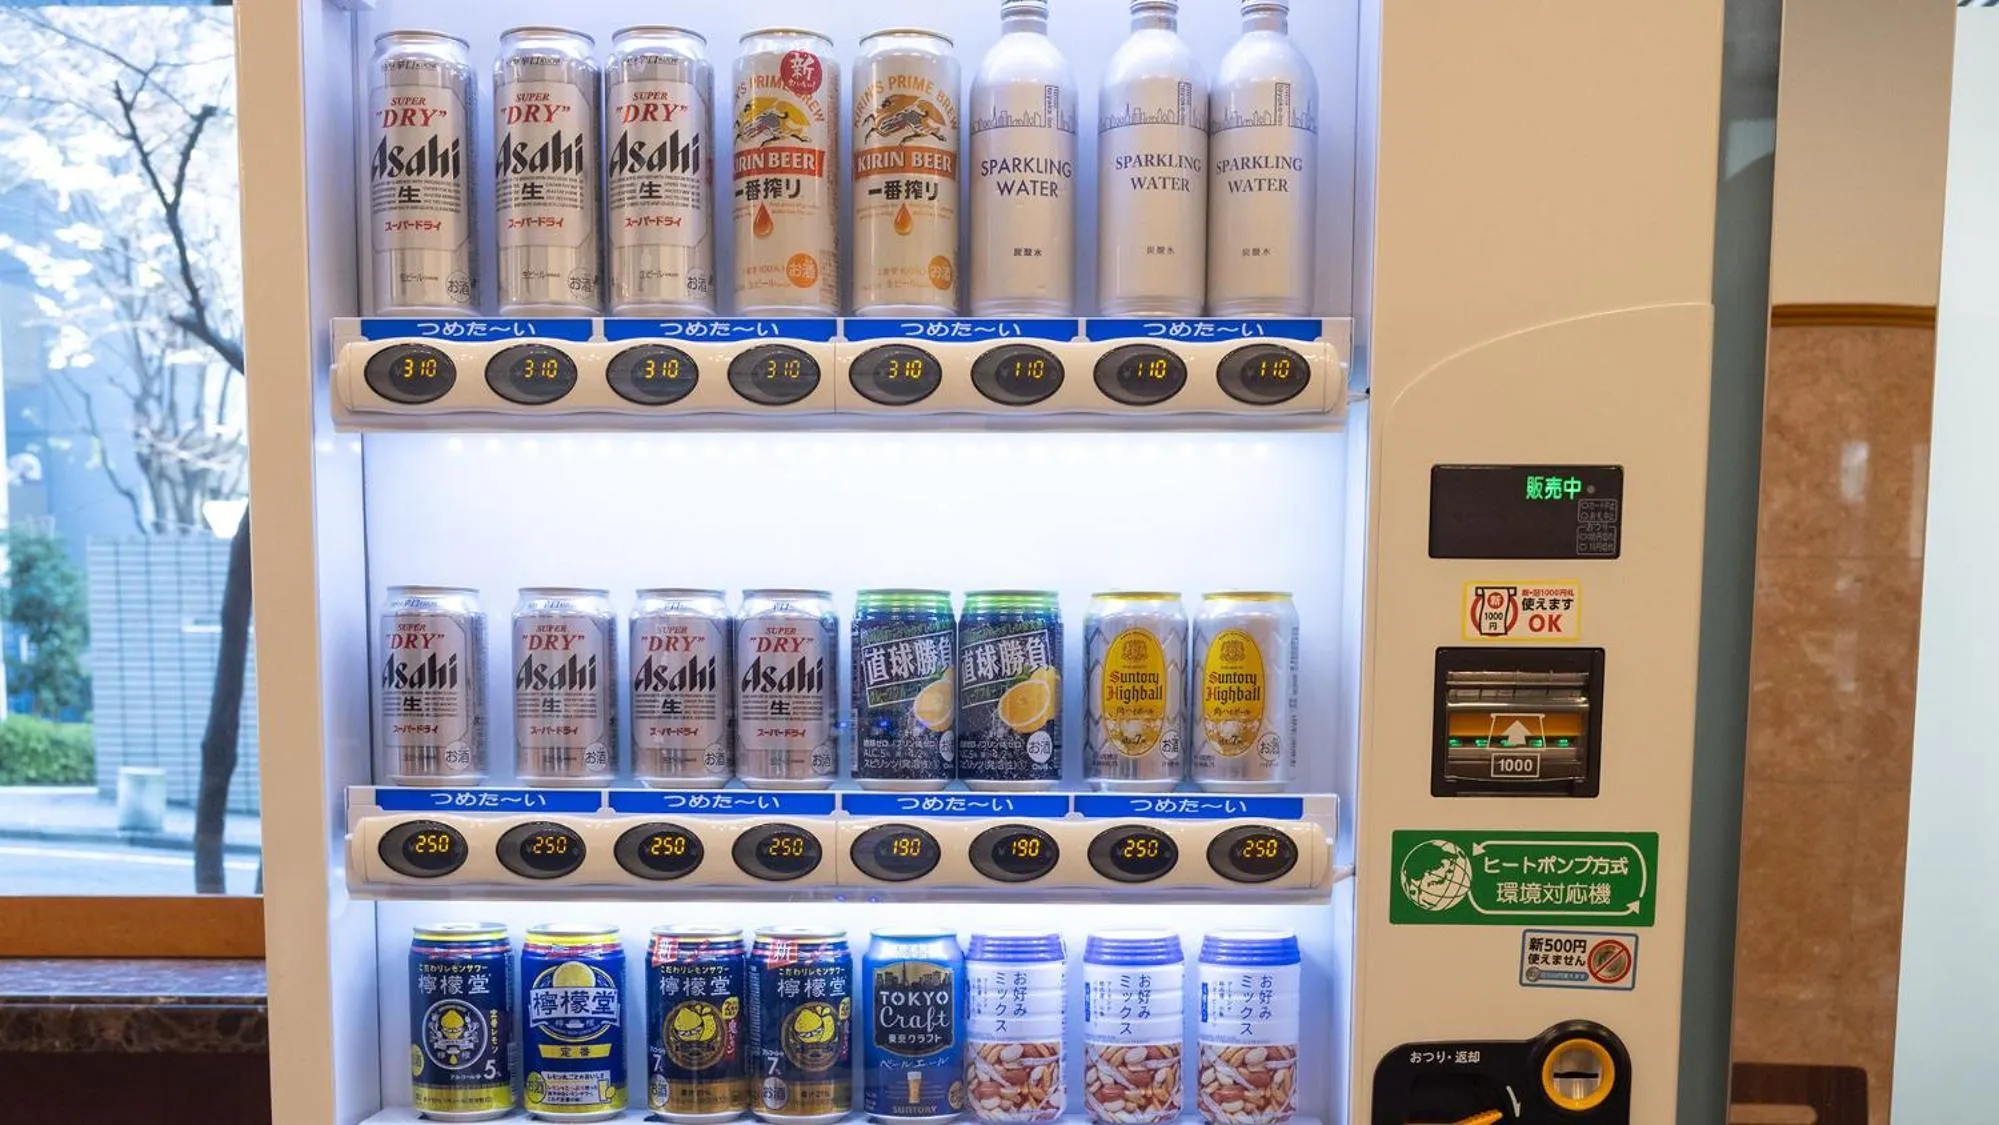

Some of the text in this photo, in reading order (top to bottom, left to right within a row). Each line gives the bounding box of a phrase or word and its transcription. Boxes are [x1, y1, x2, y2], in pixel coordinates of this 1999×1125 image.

[790, 53, 815, 80] 新
[888, 75, 934, 94] PRIME
[391, 96, 426, 106] SUPER
[516, 93, 550, 102] SUPER
[633, 91, 668, 101] SUPER
[371, 134, 460, 182] Asahi
[496, 130, 583, 178] Asahi
[610, 130, 699, 178] Asahi
[768, 152, 815, 169] BEER
[857, 151, 952, 172] KIRIN BEER
[1115, 154, 1201, 172] SPARKLING
[981, 157, 1072, 178] SPARKLING
[1216, 155, 1302, 173] SPARKLING
[521, 182, 544, 200] 生
[639, 182, 662, 199] 生
[735, 178, 800, 200] 一番搾り
[868, 180, 938, 200] 一番搾り
[997, 180, 1058, 198] WATER
[1131, 176, 1190, 192] WATER
[1228, 178, 1288, 193] WATER
[398, 186, 421, 204] 生
[385, 220, 441, 232] スーパードライ
[507, 217, 564, 229] スーパードライ
[625, 217, 682, 228] スーパードライ
[403, 359, 437, 378] 310
[524, 359, 557, 378] 310
[644, 359, 678, 379] 310
[766, 359, 800, 379] 310
[888, 359, 922, 379] 310
[1013, 359, 1044, 379] 110
[1137, 359, 1166, 379] 110
[1259, 359, 1290, 379] 110
[1526, 476, 1582, 500] 販売中
[1522, 598, 1574, 611] 使えます
[1485, 612, 1503, 620] 1000
[1529, 614, 1562, 632] OK
[536, 624, 567, 633] SUPER
[656, 626, 688, 634] SUPER
[766, 627, 797, 635] SUPER
[1489, 622, 1497, 630] 円
[382, 652, 458, 689] Asahi
[865, 638, 953, 686] 直球勝負
[961, 638, 1047, 686] 直球勝負
[516, 653, 596, 691] Asahi
[635, 654, 716, 692] Asahi
[742, 656, 823, 693] Asahi
[1110, 671, 1159, 685] Suntory
[1208, 672, 1257, 685] Suntory
[1107, 686, 1163, 704] Highball
[1205, 687, 1260, 704] Highball
[403, 697, 422, 712] 生
[542, 698, 562, 713] 生
[662, 699, 682, 714] 生
[770, 700, 790, 715] 生
[393, 725, 438, 734] スーパードライ
[530, 726, 578, 735] スーパードライ
[650, 728, 699, 736] スーパードライ
[757, 729, 806, 737] スーパードライ
[446, 750, 470, 764] お酒
[585, 750, 608, 764] お酒
[705, 753, 725, 766] お酒
[813, 754, 832, 767] お酒
[1499, 759, 1533, 772] 1000
[415, 835, 448, 853] 250
[533, 836, 566, 854] 250
[651, 837, 684, 855] 250
[768, 838, 802, 856] 250
[892, 839, 920, 856] 190
[1011, 839, 1039, 857] 190
[1123, 839, 1157, 858] 250
[1242, 839, 1276, 858] 250
[1484, 856, 1629, 875] ヒートポンプ方式
[1496, 882, 1611, 904] 環境対応機
[1529, 938, 1587, 953] 新500円
[1528, 954, 1586, 967] 使えません
[779, 968, 845, 976] こだわりレモンサワー
[419, 974, 490, 994] 檸檬堂
[660, 976, 730, 996] 檸檬堂
[777, 978, 846, 998] 檸檬堂
[534, 990, 614, 1015] 檸檬堂
[880, 991, 948, 1006] TOKYO
[995, 973, 1007, 1032] ミックス
[1014, 972, 1027, 1016] お好み
[1138, 975, 1151, 1019] お好み
[1259, 975, 1273, 1019] お好み
[1120, 975, 1132, 1035] ミックス
[1240, 975, 1252, 1035] ミックス
[880, 1006, 949, 1032] Craft
[889, 1034, 942, 1044] 東京クラフト
[561, 1048, 590, 1056] 定番
[1410, 1051, 1480, 1064] おつり・返却
[880, 1058, 949, 1069] ペールエール
